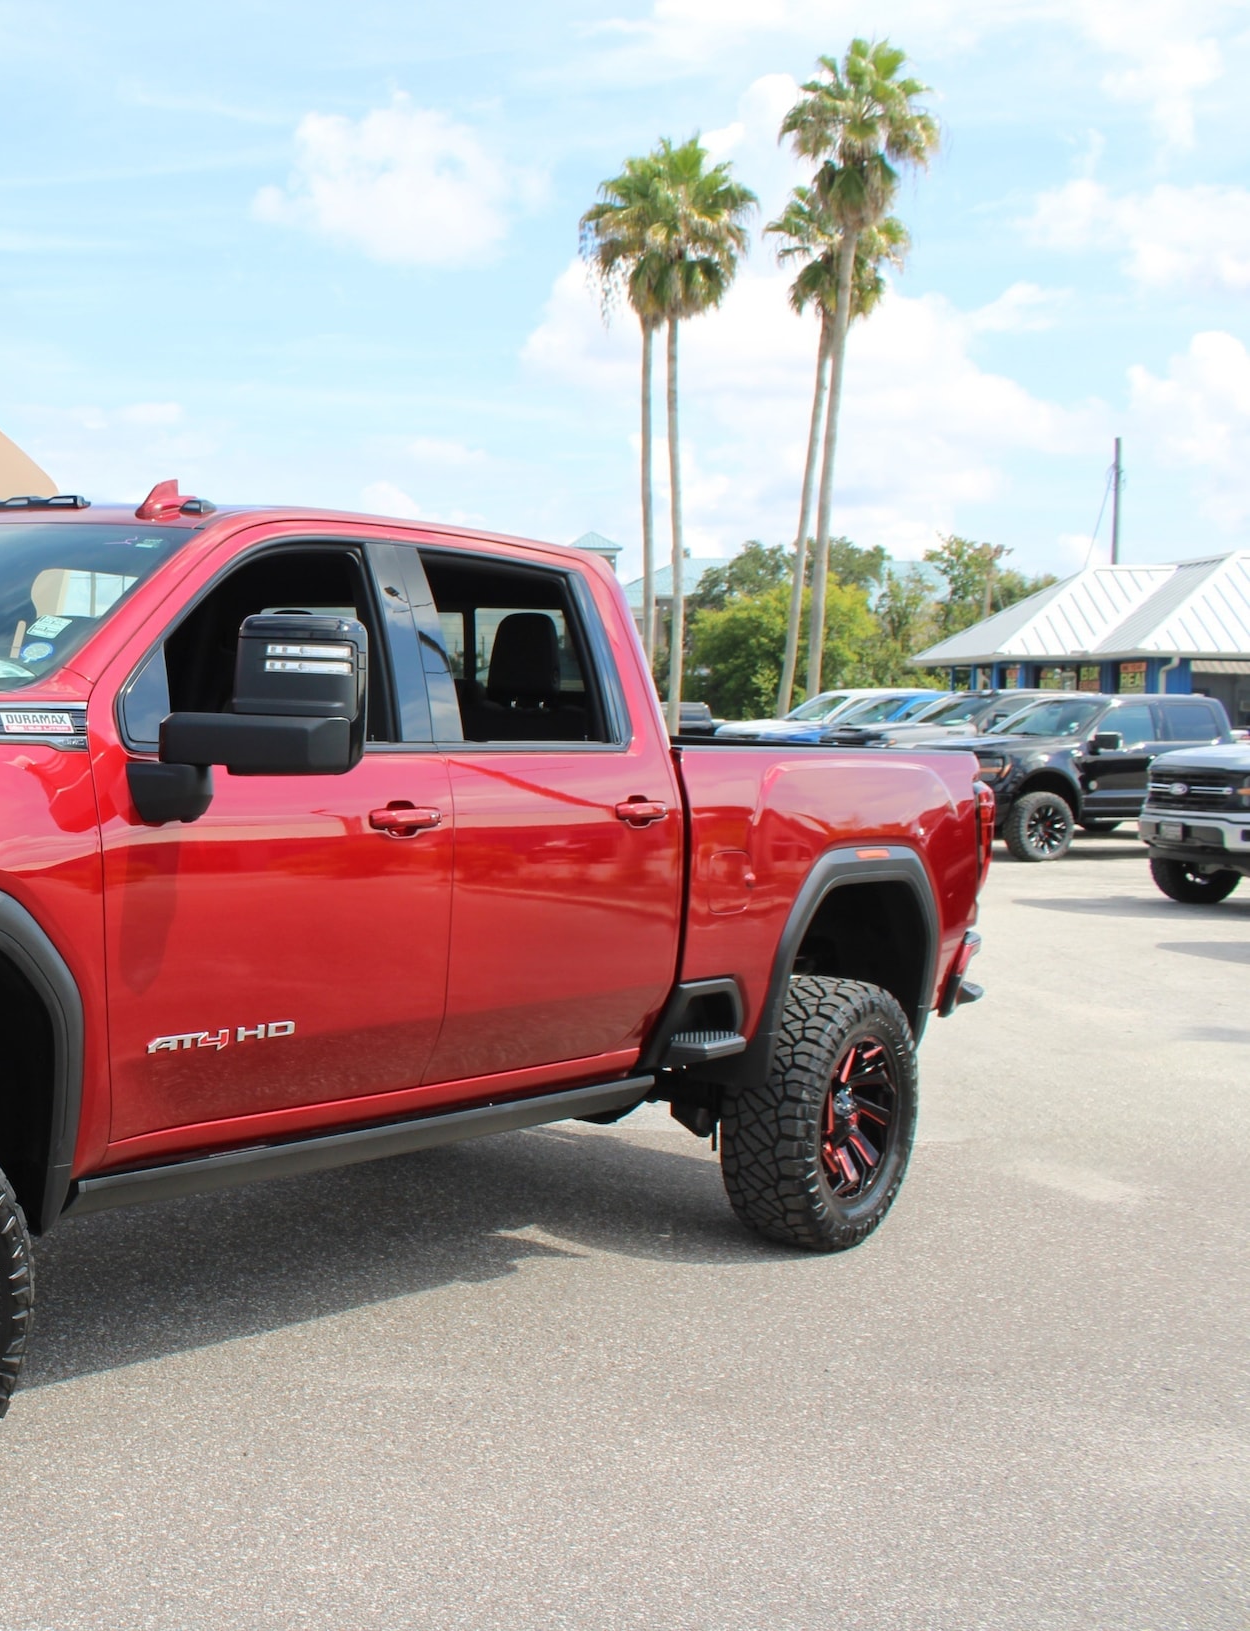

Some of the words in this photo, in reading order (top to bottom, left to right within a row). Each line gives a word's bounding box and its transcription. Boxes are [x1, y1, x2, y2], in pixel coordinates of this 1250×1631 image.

[5, 713, 67, 725] DURAMAX
[147, 1028, 230, 1054] AT4
[236, 1020, 296, 1042] HD
